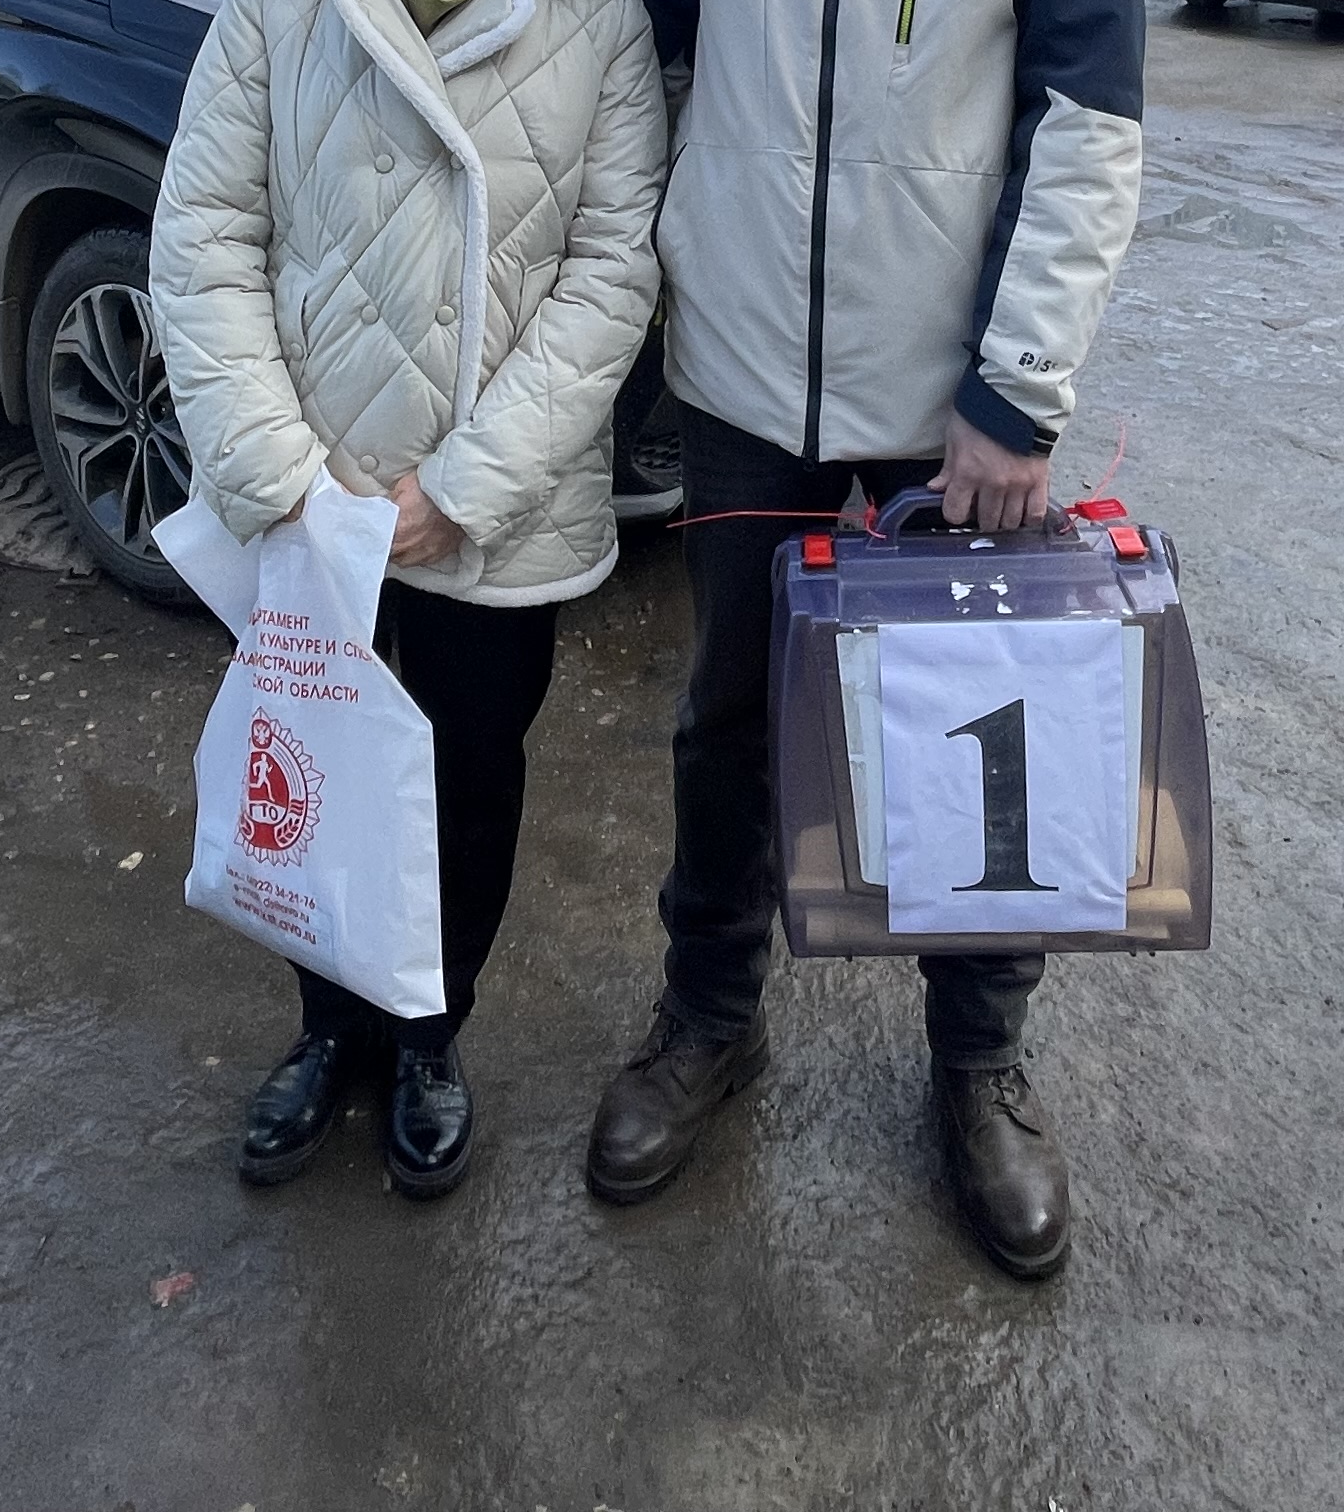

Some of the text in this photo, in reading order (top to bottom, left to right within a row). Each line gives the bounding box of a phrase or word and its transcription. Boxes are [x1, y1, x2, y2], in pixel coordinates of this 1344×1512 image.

[259, 632, 321, 655] КУЛЬТУРЕ
[325, 640, 336, 655] И
[289, 681, 359, 704] ОБЛАСТИ
[945, 698, 1061, 892] 1
[249, 803, 278, 821] ГТО
